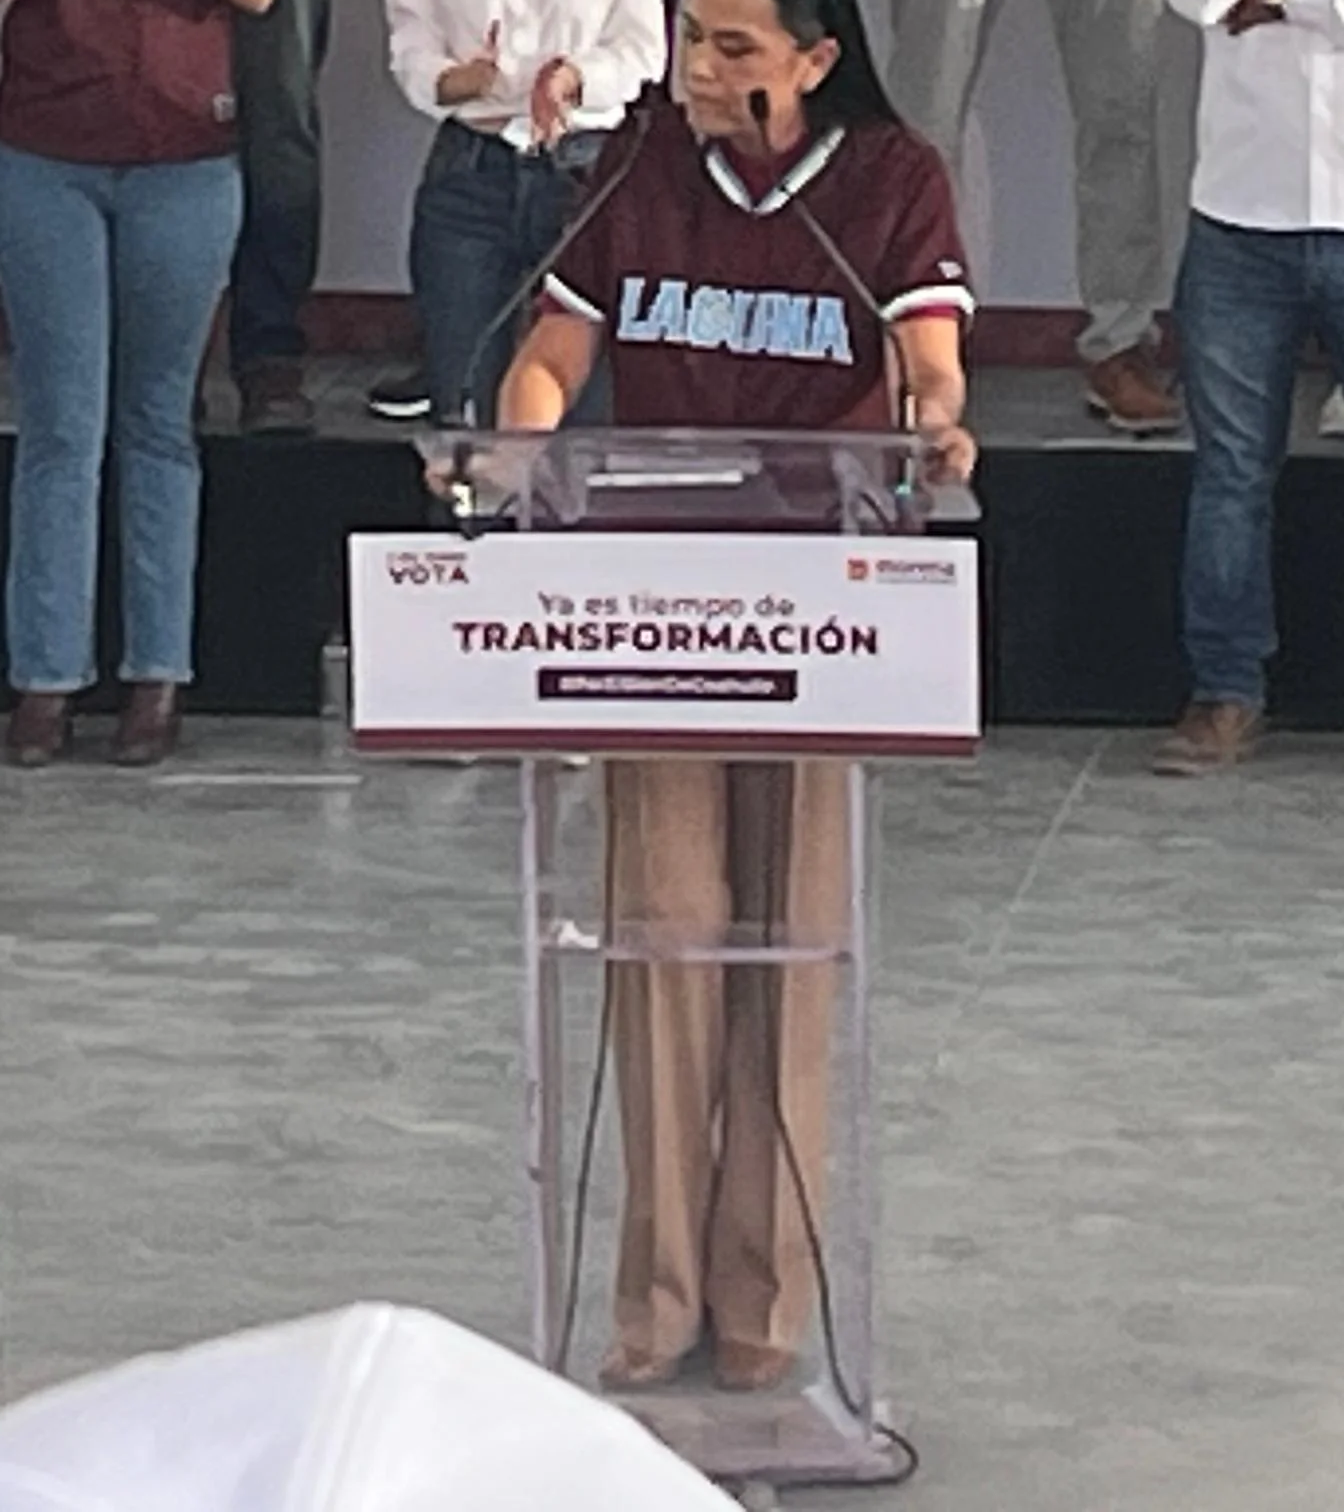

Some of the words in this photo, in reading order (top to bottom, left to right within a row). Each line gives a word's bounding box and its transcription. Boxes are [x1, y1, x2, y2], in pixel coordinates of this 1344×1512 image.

[538, 591, 576, 617] Ya
[584, 595, 620, 616] es
[628, 591, 745, 621] tiempo
[753, 594, 797, 618] de
[453, 615, 879, 656] TRANSFORMACIÓN
